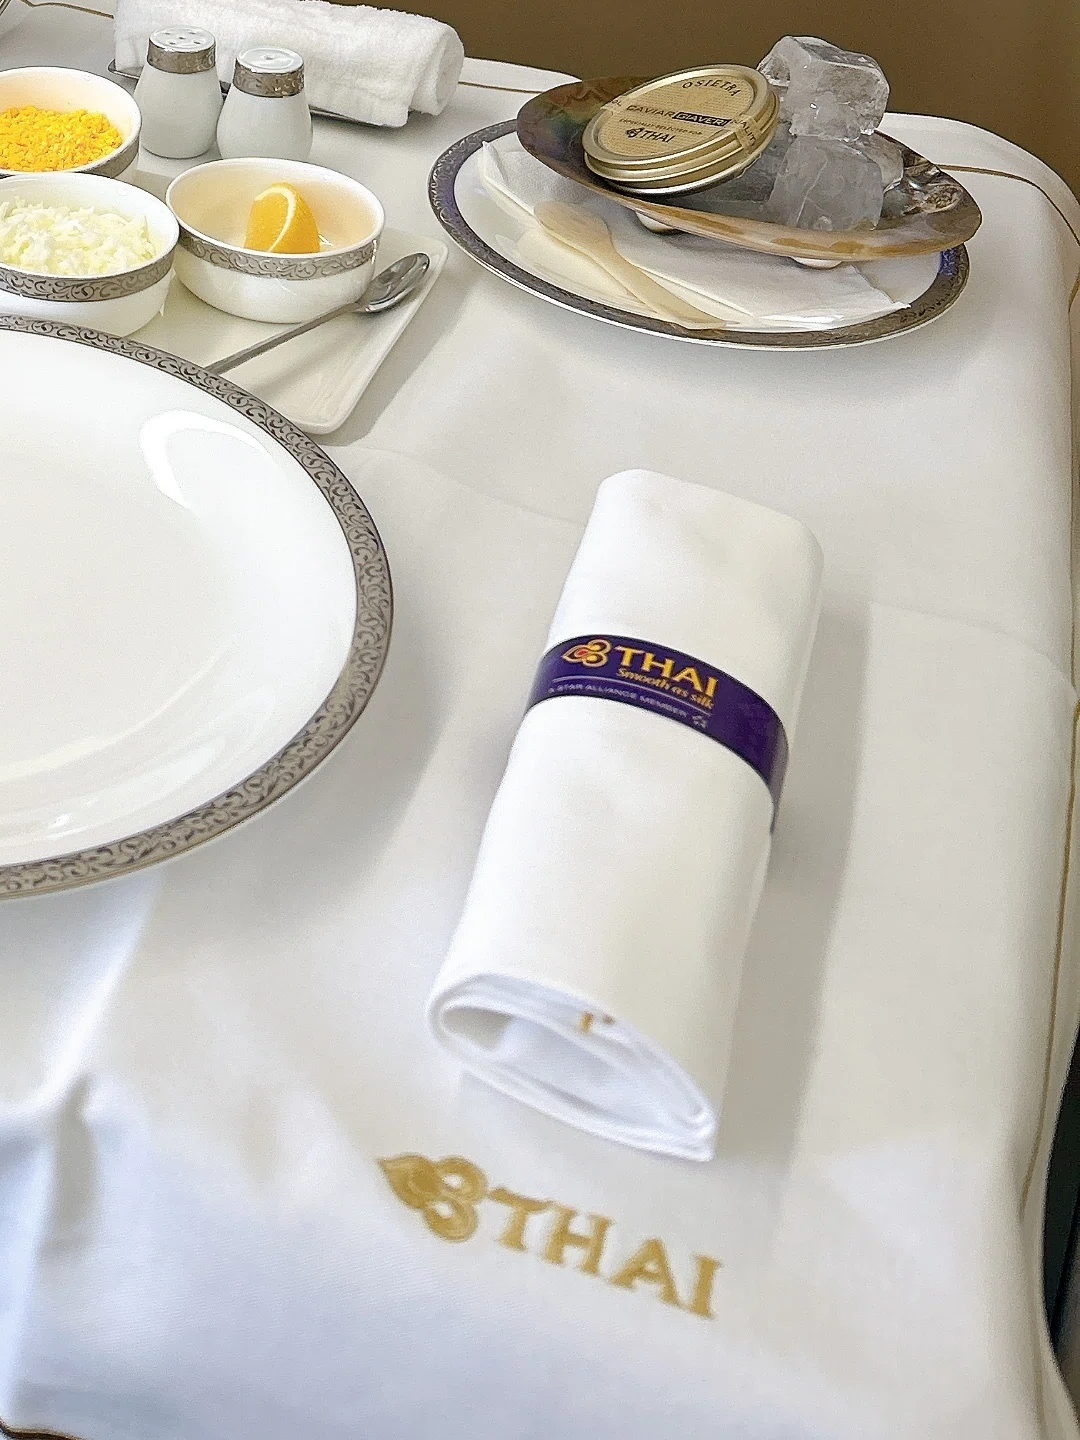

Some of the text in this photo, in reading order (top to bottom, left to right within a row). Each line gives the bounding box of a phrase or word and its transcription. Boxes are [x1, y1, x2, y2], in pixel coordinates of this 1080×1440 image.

[682, 79, 741, 97] OSIETRA
[626, 104, 728, 126] CAVIAR GIAVERI
[640, 129, 676, 143] THAI
[614, 646, 719, 697] THAI
[615, 667, 715, 710] Smooth as silk
[556, 683, 583, 692] STAR
[584, 683, 638, 700] ALLIANCE
[639, 695, 688, 718] MEMBER
[487, 1185, 723, 1319] THAI
